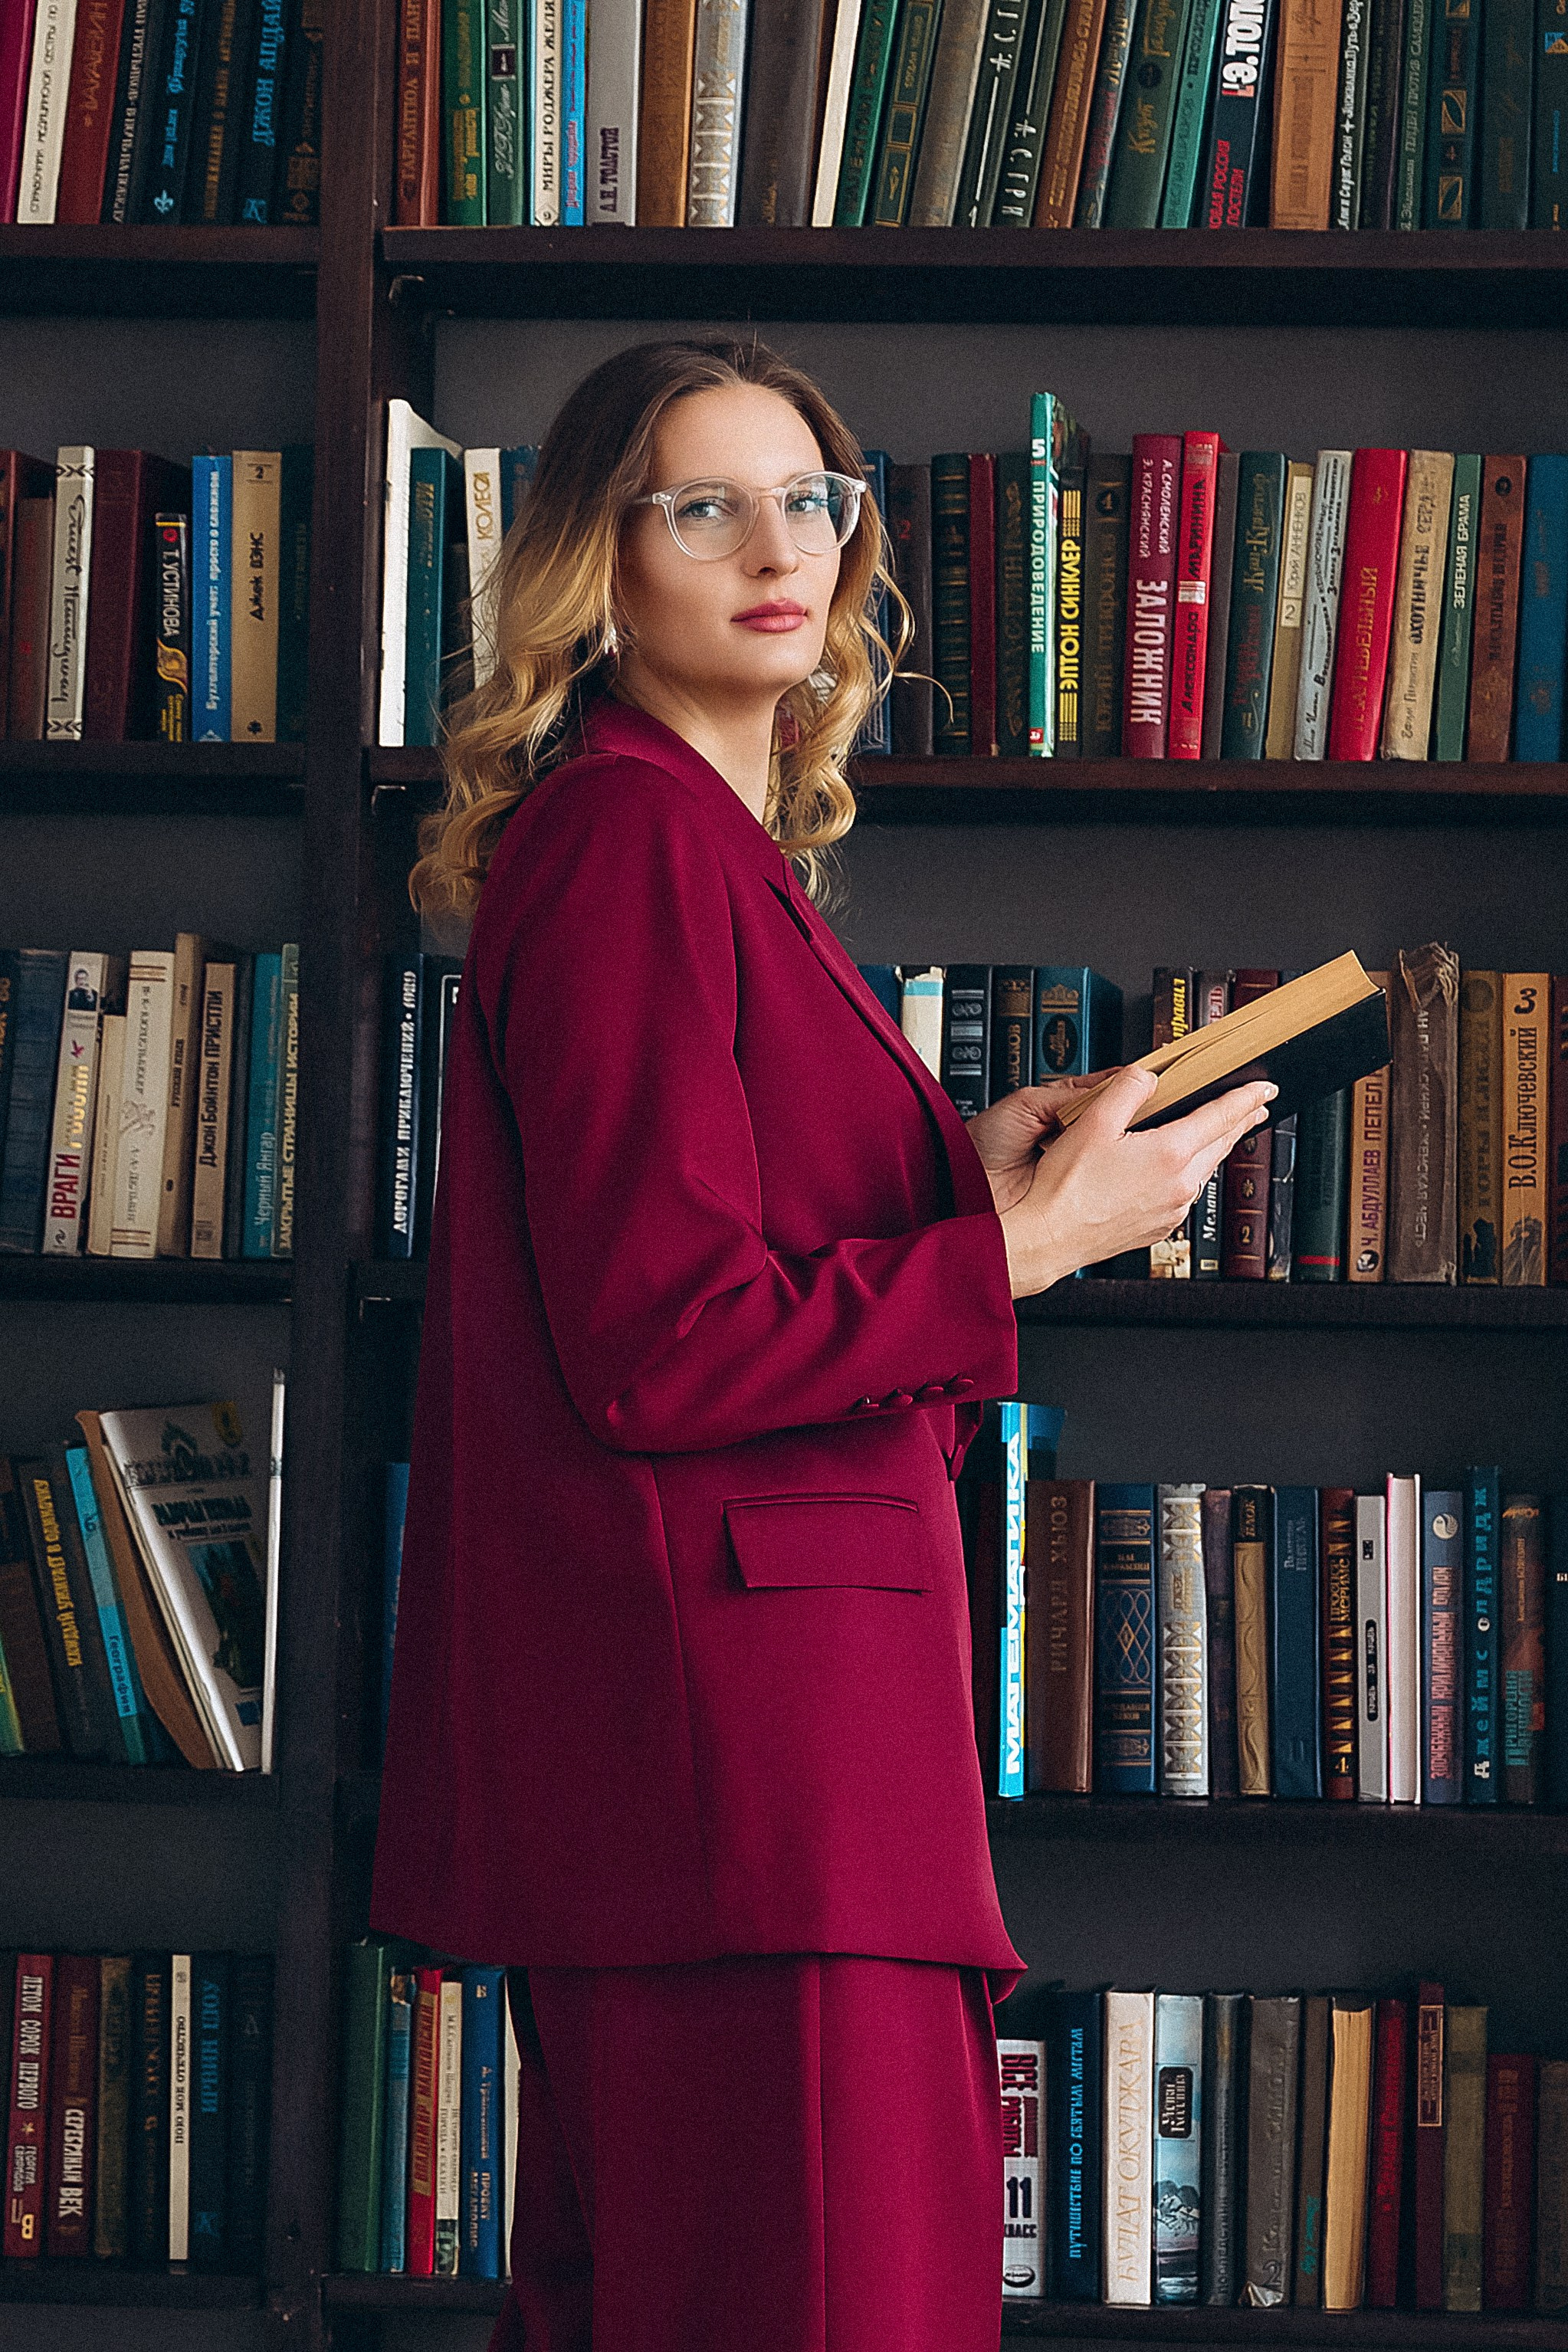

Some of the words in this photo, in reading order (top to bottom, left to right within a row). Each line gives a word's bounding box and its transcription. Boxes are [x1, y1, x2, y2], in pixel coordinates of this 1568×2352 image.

[405, 51, 420, 65] И
[253, 78, 275, 146] ДЖОН
[402, 77, 420, 181] ГАРГАНТЮА
[542, 56, 556, 136] РОДЖЕРА
[542, 141, 555, 192] МИРЫ
[599, 126, 619, 184] ТОЛСТОЙ
[1212, 139, 1231, 189] РОССИЯ
[1226, 167, 1245, 227] ПОСТЕЛИ
[1032, 438, 1045, 458] 5
[473, 471, 494, 540] КОЛЕСА
[1138, 472, 1153, 559] КРАСНЯНСКИЙ
[1158, 473, 1173, 555] СМОЛЕНСКИЙ
[1188, 478, 1206, 579] МАРИНИНА
[1457, 494, 1471, 542] БРАМА
[250, 532, 264, 569] ВЭНС
[1031, 480, 1045, 653] ПРИРОДОВЕДЕНИЕ
[1061, 539, 1081, 621] СИНКЛЕР
[1453, 545, 1467, 609] ЗЕЛЕНАЯ
[162, 562, 181, 638] УСТИНОВА
[250, 576, 264, 622] Джек
[1060, 625, 1079, 690] ЭПТОН
[1130, 579, 1168, 725] ЗАЛОЖНИК
[204, 990, 223, 1058] ПРИСТЛИ
[286, 992, 299, 1069] ИСТОРИИ
[1513, 987, 1537, 1015] 3
[397, 1022, 415, 1140] ПРИКЛЮЧЕНИЙ
[1007, 1023, 1022, 1090] ЛЕСКОВ
[201, 1061, 221, 1123] Бойнтон
[282, 1073, 297, 1163] СТРАНИЦЫ
[1364, 1081, 1383, 1141] ПЕПЕЛ
[198, 1125, 218, 1168] Джон
[50, 1153, 80, 1219] ВРАГИ
[254, 1175, 273, 1225] Черный
[279, 1165, 294, 1249] ЗАКРЫТЫЕ
[393, 1146, 409, 1234] ДОРОГАМИ
[1202, 1181, 1217, 1242] Мелани
[1362, 1150, 1383, 1230] АБДУЛЛАЕВ
[1051, 1495, 1068, 1564] ХЬЮЗ
[1243, 1498, 1256, 1537] БЛОК
[1006, 1432, 1020, 1775] МАТЕМАТИКА
[1051, 1579, 1068, 1671] РИЧАРД
[1471, 1648, 1491, 1779] Джеймс
[21, 1975, 42, 2013] ЛЕТОМ
[202, 1980, 221, 2030] ШОУ
[19, 2019, 41, 2055] СОРОК
[175, 2015, 186, 2084] ОТЕЧЕСТВО
[415, 2003, 434, 2098] МАЯКОВСКИЙ
[17, 2062, 40, 2109] ПЕРВОГО
[175, 2086, 185, 2111] МОЕ
[201, 2039, 219, 2113] ИРВИН
[1117, 2016, 1145, 2181] ОКУДЖАВА
[62, 2108, 85, 2183] СЕРЕБРЯНЫЙ
[175, 2115, 185, 2144] ПОЮ
[414, 2104, 431, 2183] ВЛАДИМИР
[58, 2186, 84, 2218] ВЕК
[481, 2172, 491, 2221] ПРОЕКТ
[1005, 2177, 1032, 2219] 11
[1115, 2186, 1142, 2282] БУЛАТ
